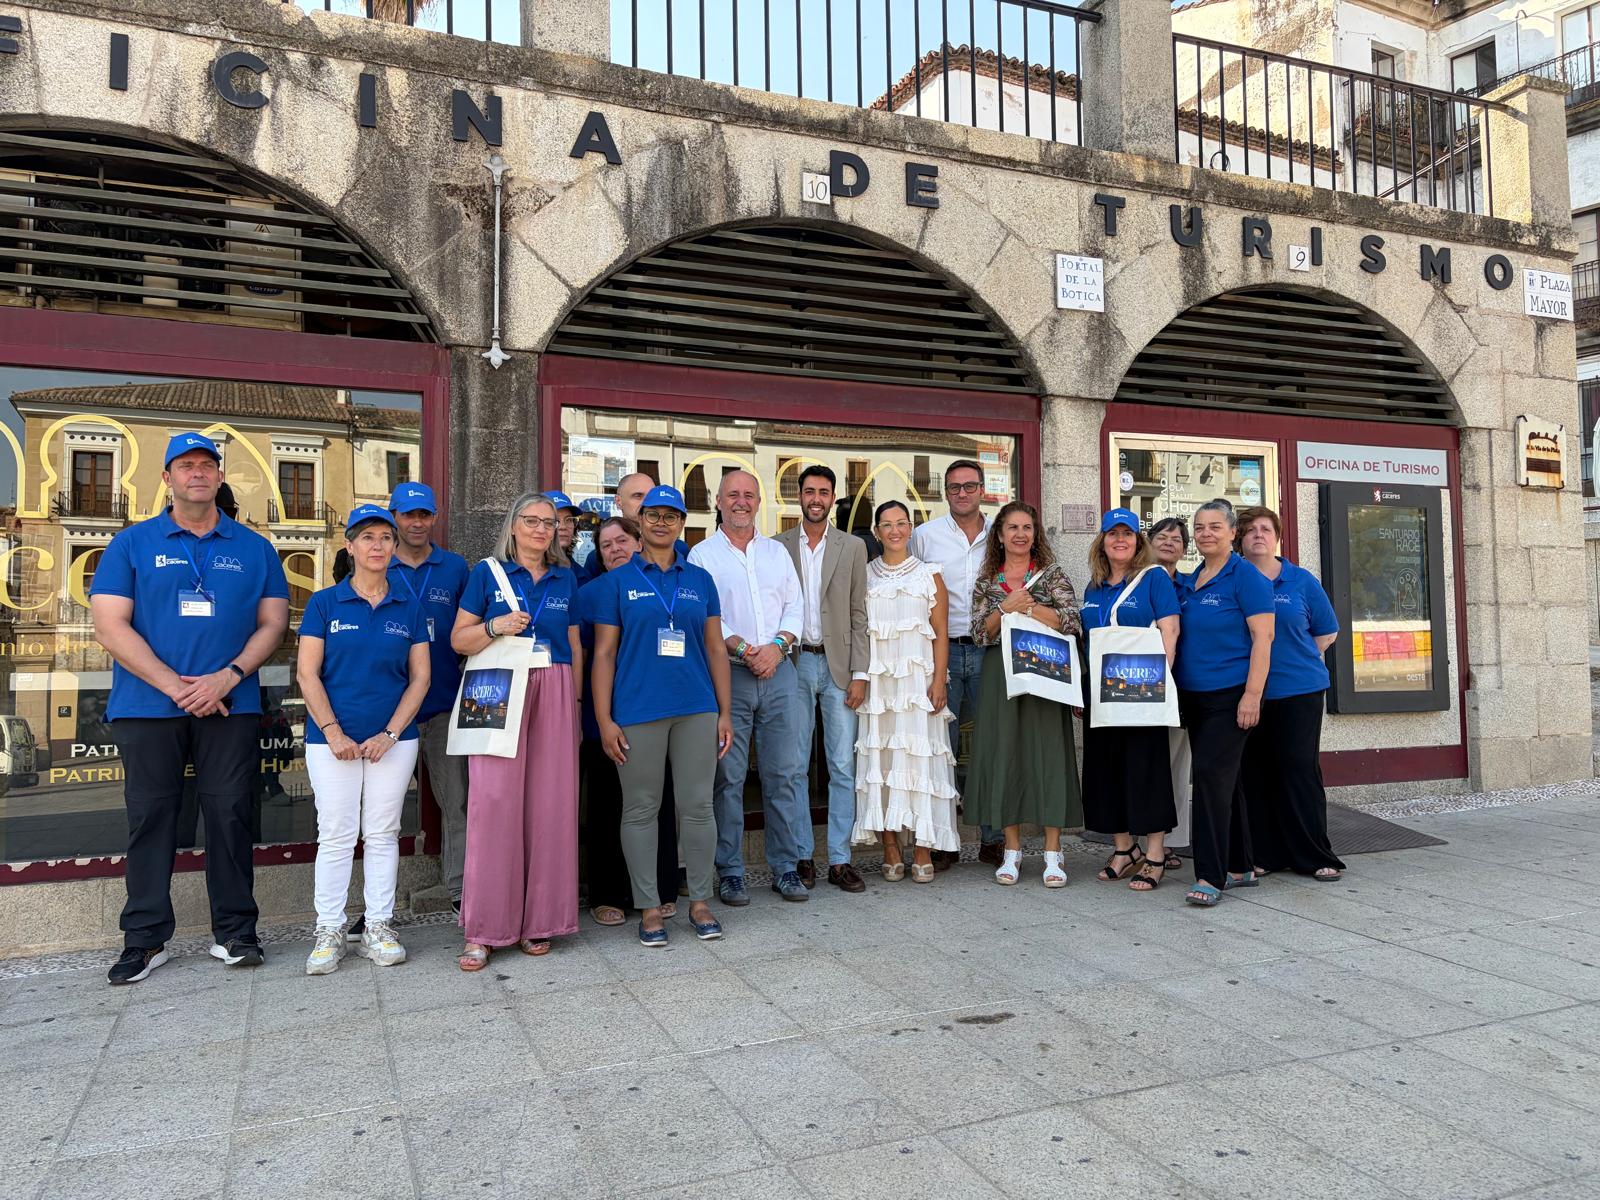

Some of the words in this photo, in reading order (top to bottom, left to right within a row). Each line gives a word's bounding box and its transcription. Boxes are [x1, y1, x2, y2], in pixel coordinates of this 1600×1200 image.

[806, 180, 829, 201] 10
[830, 150, 940, 209] DE
[1094, 193, 1514, 291] TURISMO
[1060, 257, 1102, 273] PORTAL
[1294, 250, 1307, 269] 9
[1065, 275, 1079, 285] DE
[1084, 277, 1097, 286] LA
[1539, 275, 1571, 293] PLAZA
[1061, 287, 1102, 302] BOTICA
[1530, 294, 1568, 317] MAYOR
[1305, 456, 1360, 471] OFICINA
[1363, 461, 1381, 472] DE
[1383, 460, 1440, 476] TURISMO
[1169, 501, 1201, 513] HOL
[1017, 640, 1066, 662] CÁCERES
[1105, 663, 1160, 679] CÁCERES
